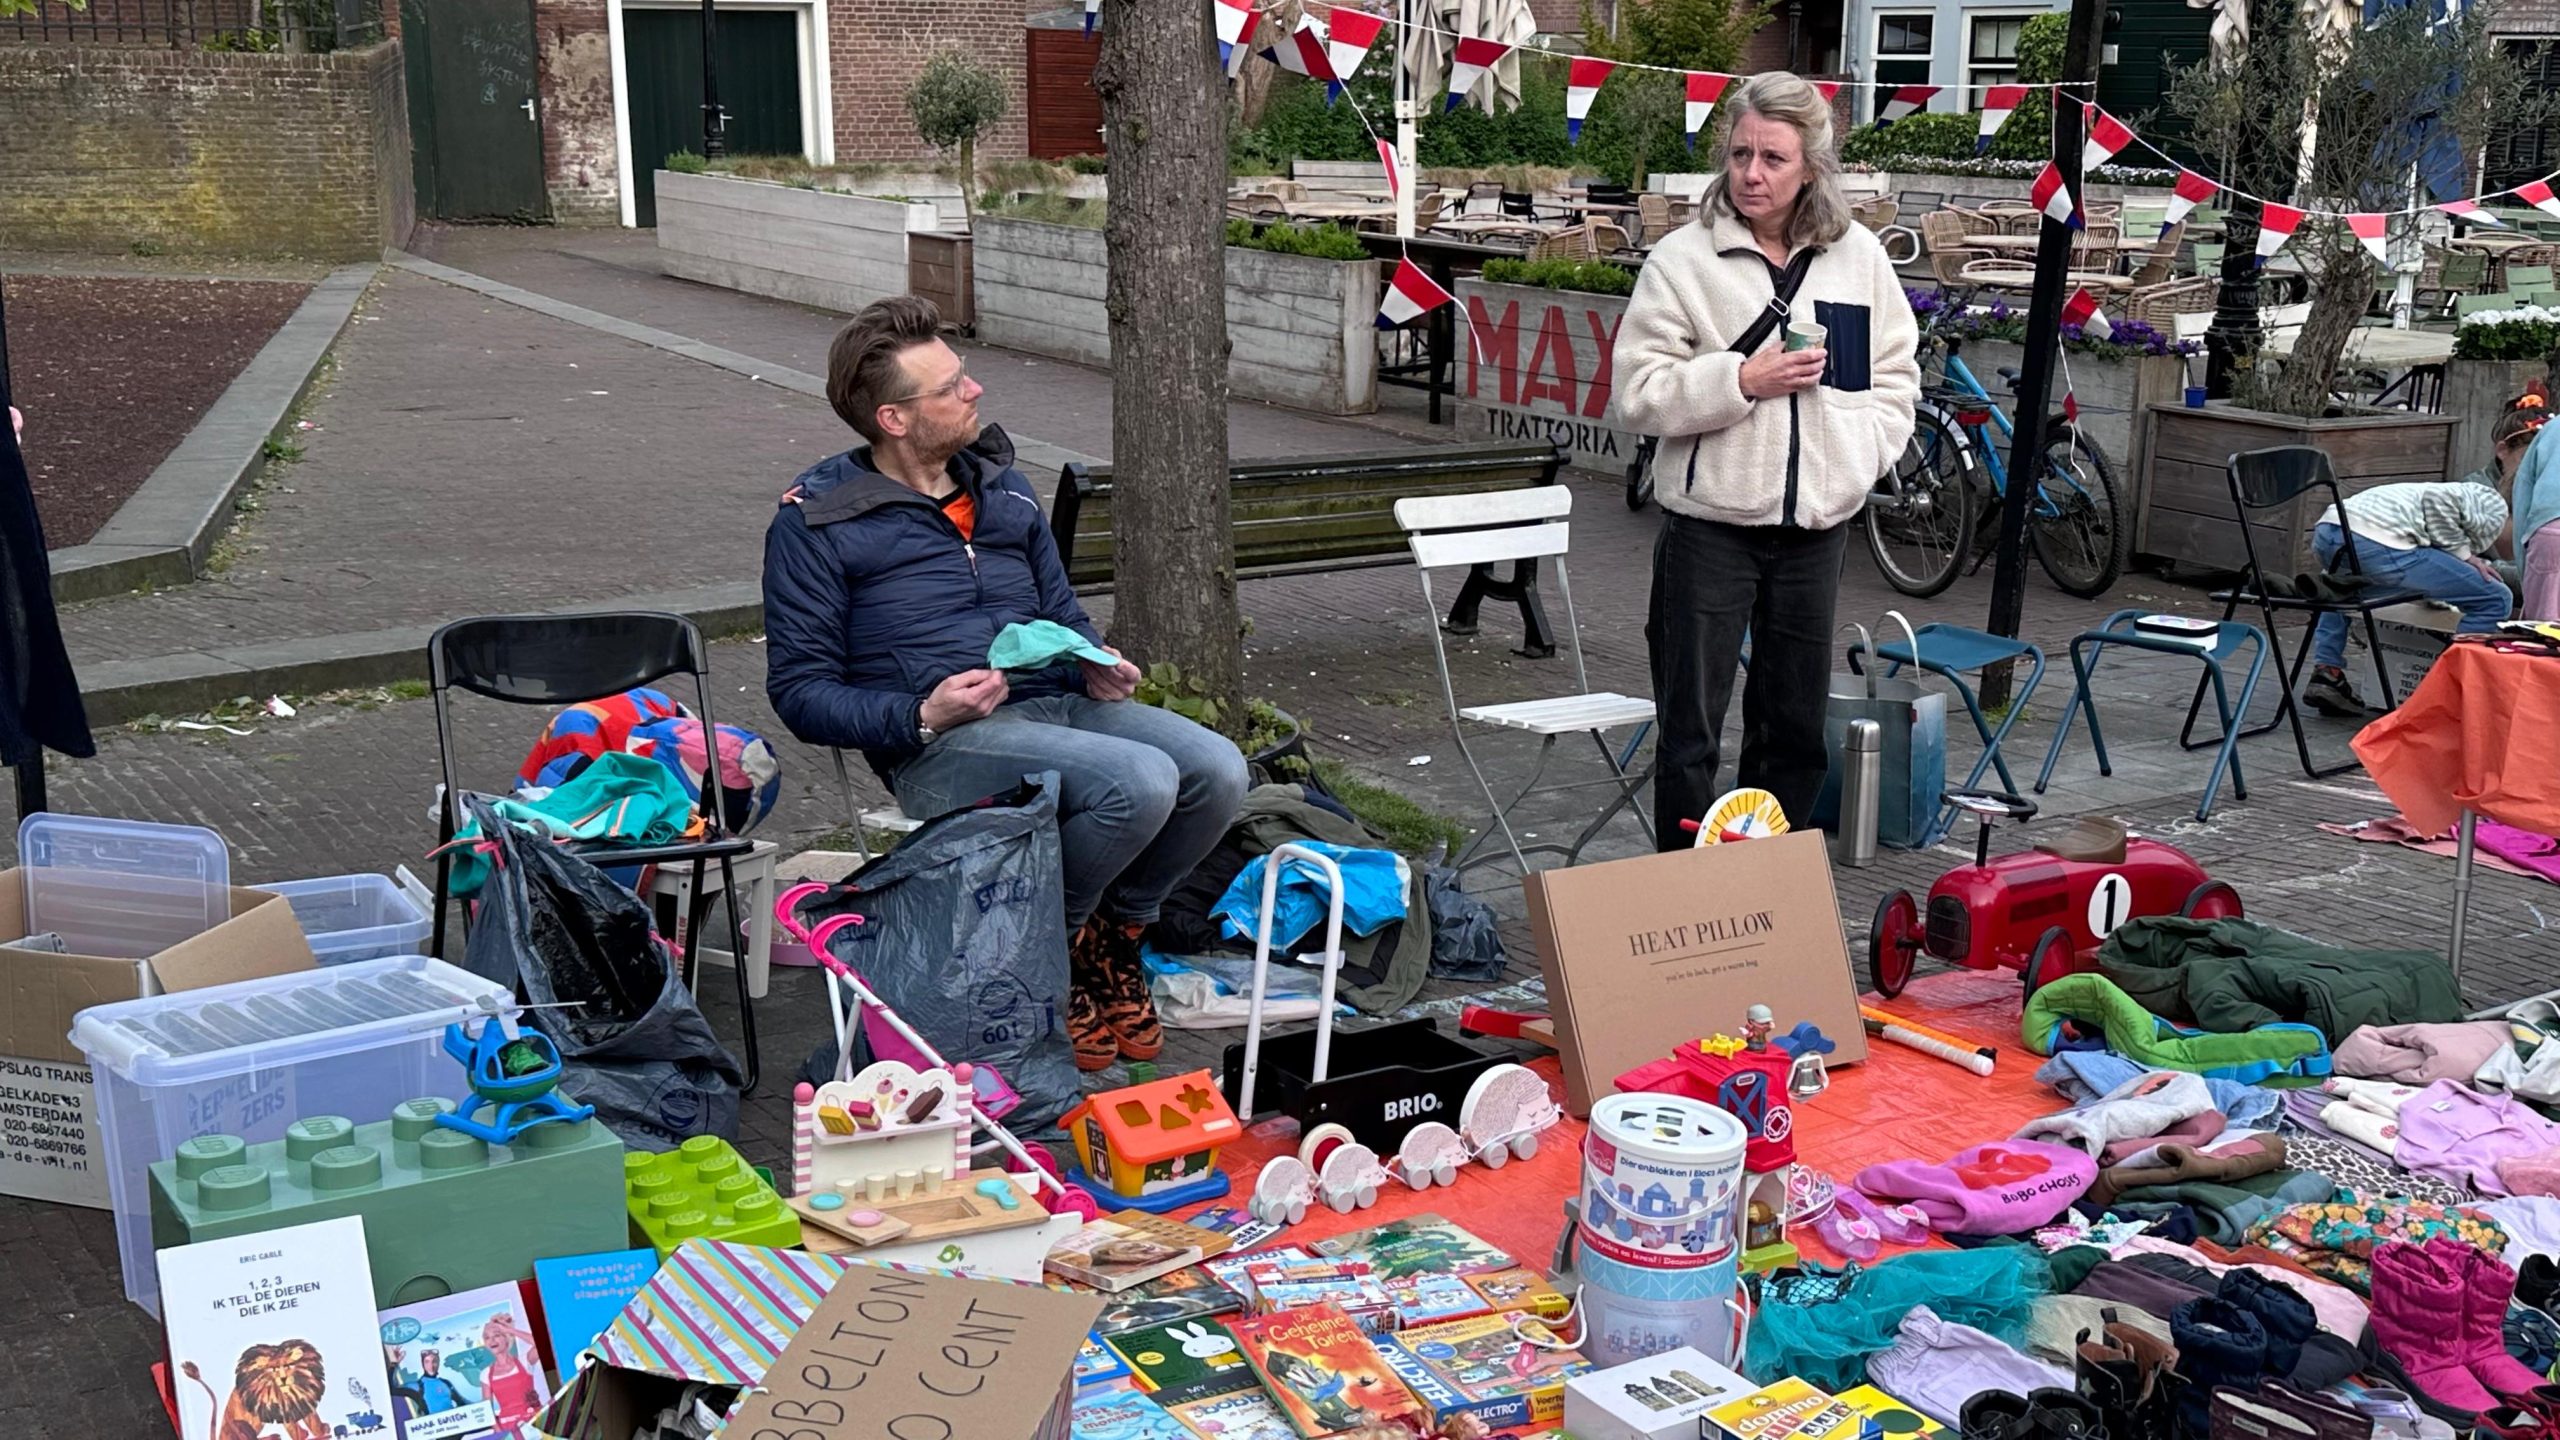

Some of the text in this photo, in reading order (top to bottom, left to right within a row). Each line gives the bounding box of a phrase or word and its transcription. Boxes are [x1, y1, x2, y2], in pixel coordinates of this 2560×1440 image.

[1467, 295, 1622, 419] MAX
[1487, 408, 1620, 458] TRATTORIA
[2103, 878, 2117, 934] 1
[1628, 910, 1774, 956] HEAT PILLOW
[982, 1025, 1009, 1045] 60
[45, 1067, 94, 1084] TRANS
[0, 1103, 83, 1124] AMSTERDAM
[1384, 1092, 1437, 1122] BRIO
[2001, 1173, 2081, 1204] BOBO CHOSES
[275, 1275, 283, 1285] 3
[213, 1281, 321, 1309] IK TEL DE DIEREN
[240, 1297, 299, 1318] DIE IK ZIE
[1268, 1316, 1348, 1341] Geheime
[1302, 1330, 1360, 1350] Toren
[1377, 1343, 1453, 1406] ELECTRO
[1200, 1391, 1266, 1415] bobb
[1737, 1395, 1824, 1433] domino
[1082, 1409, 1144, 1430] monster
